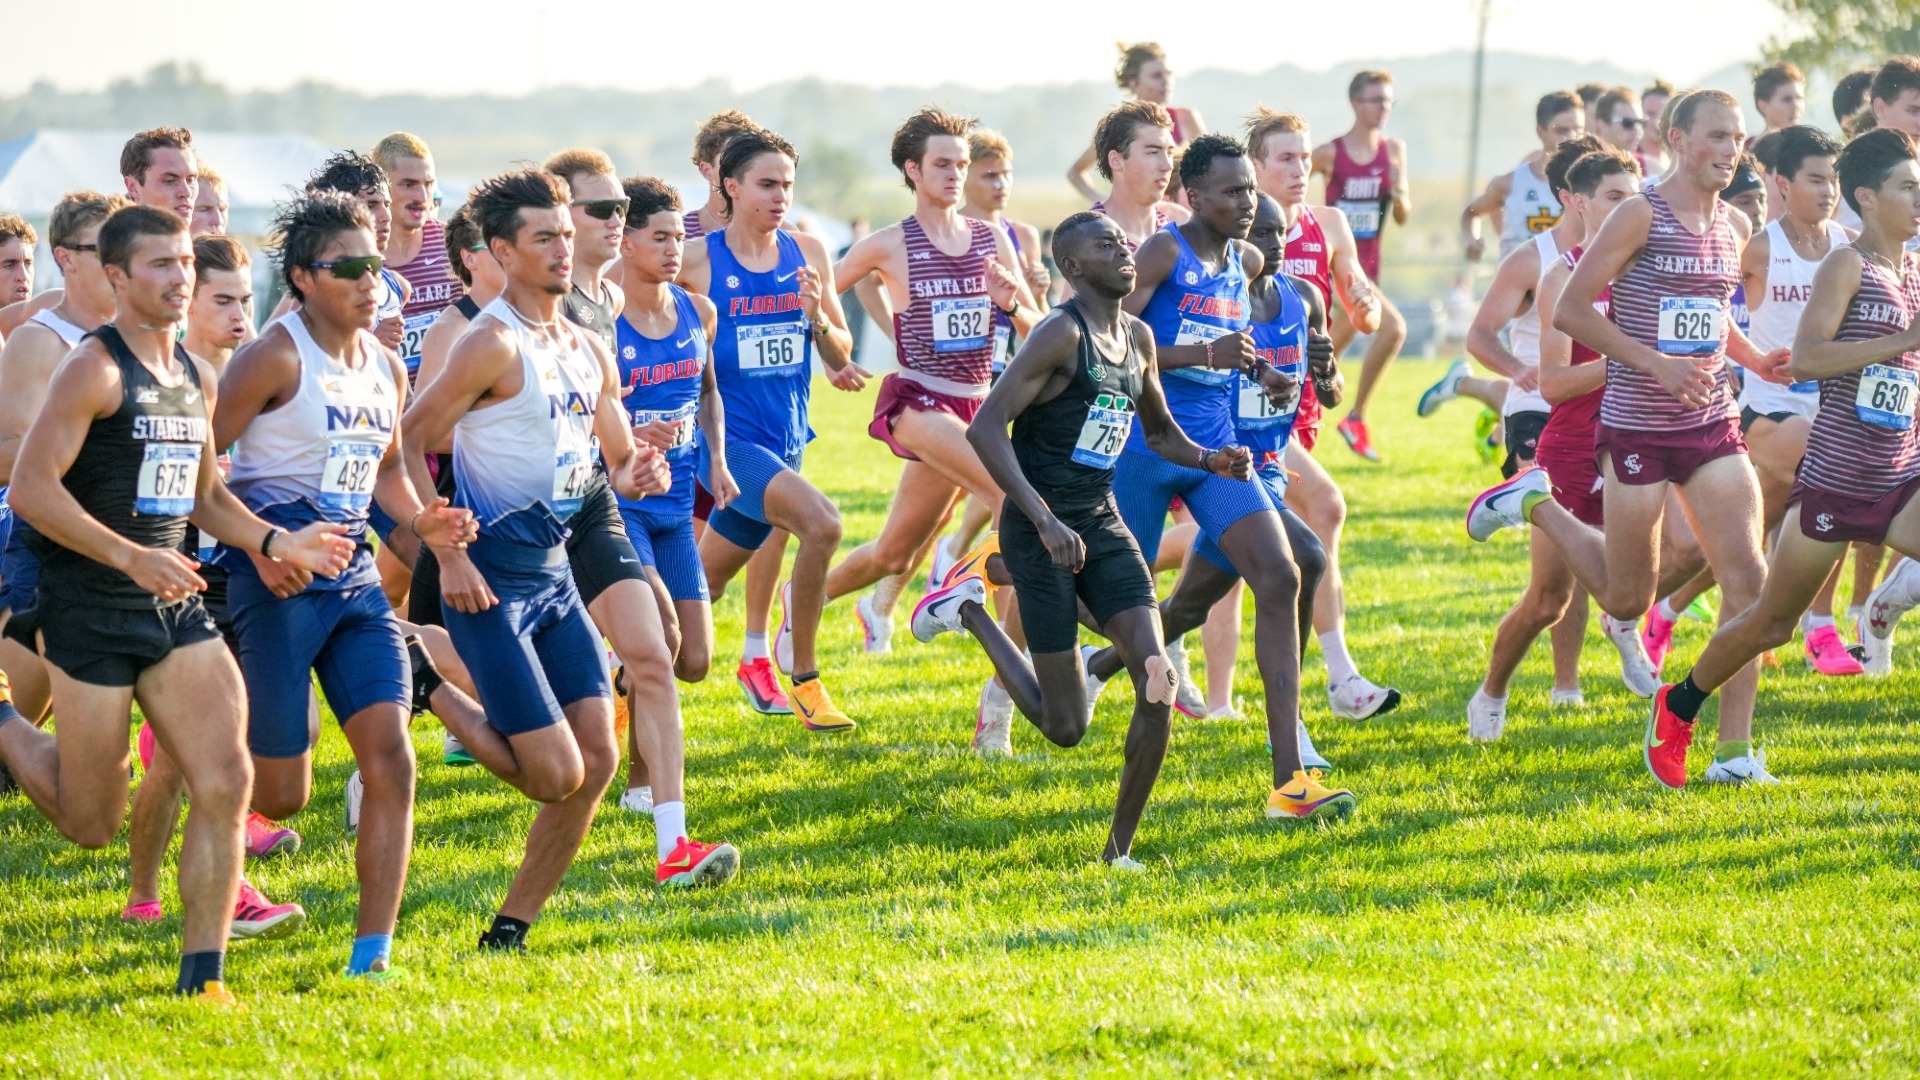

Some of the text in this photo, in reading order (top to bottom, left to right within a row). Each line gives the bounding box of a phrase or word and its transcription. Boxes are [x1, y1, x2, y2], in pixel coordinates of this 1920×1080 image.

[1283, 259, 1318, 276] NSIN
[1655, 255, 1702, 275] SANTA
[915, 275, 988, 298] SANTA CLA
[1772, 285, 1813, 302] HAR
[1177, 292, 1243, 320] FLORIDA
[948, 311, 982, 339] 632
[1674, 312, 1712, 340] 626
[755, 337, 794, 366] 156
[1255, 344, 1303, 367] RIDA
[630, 357, 703, 387] FLORIDA
[548, 391, 600, 419] NAU
[1872, 380, 1909, 413] 630
[132, 415, 208, 443] STANFOR
[325, 405, 393, 433] NAU
[1092, 423, 1125, 455] 756
[155, 464, 189, 496] 675
[337, 460, 371, 492] 482
